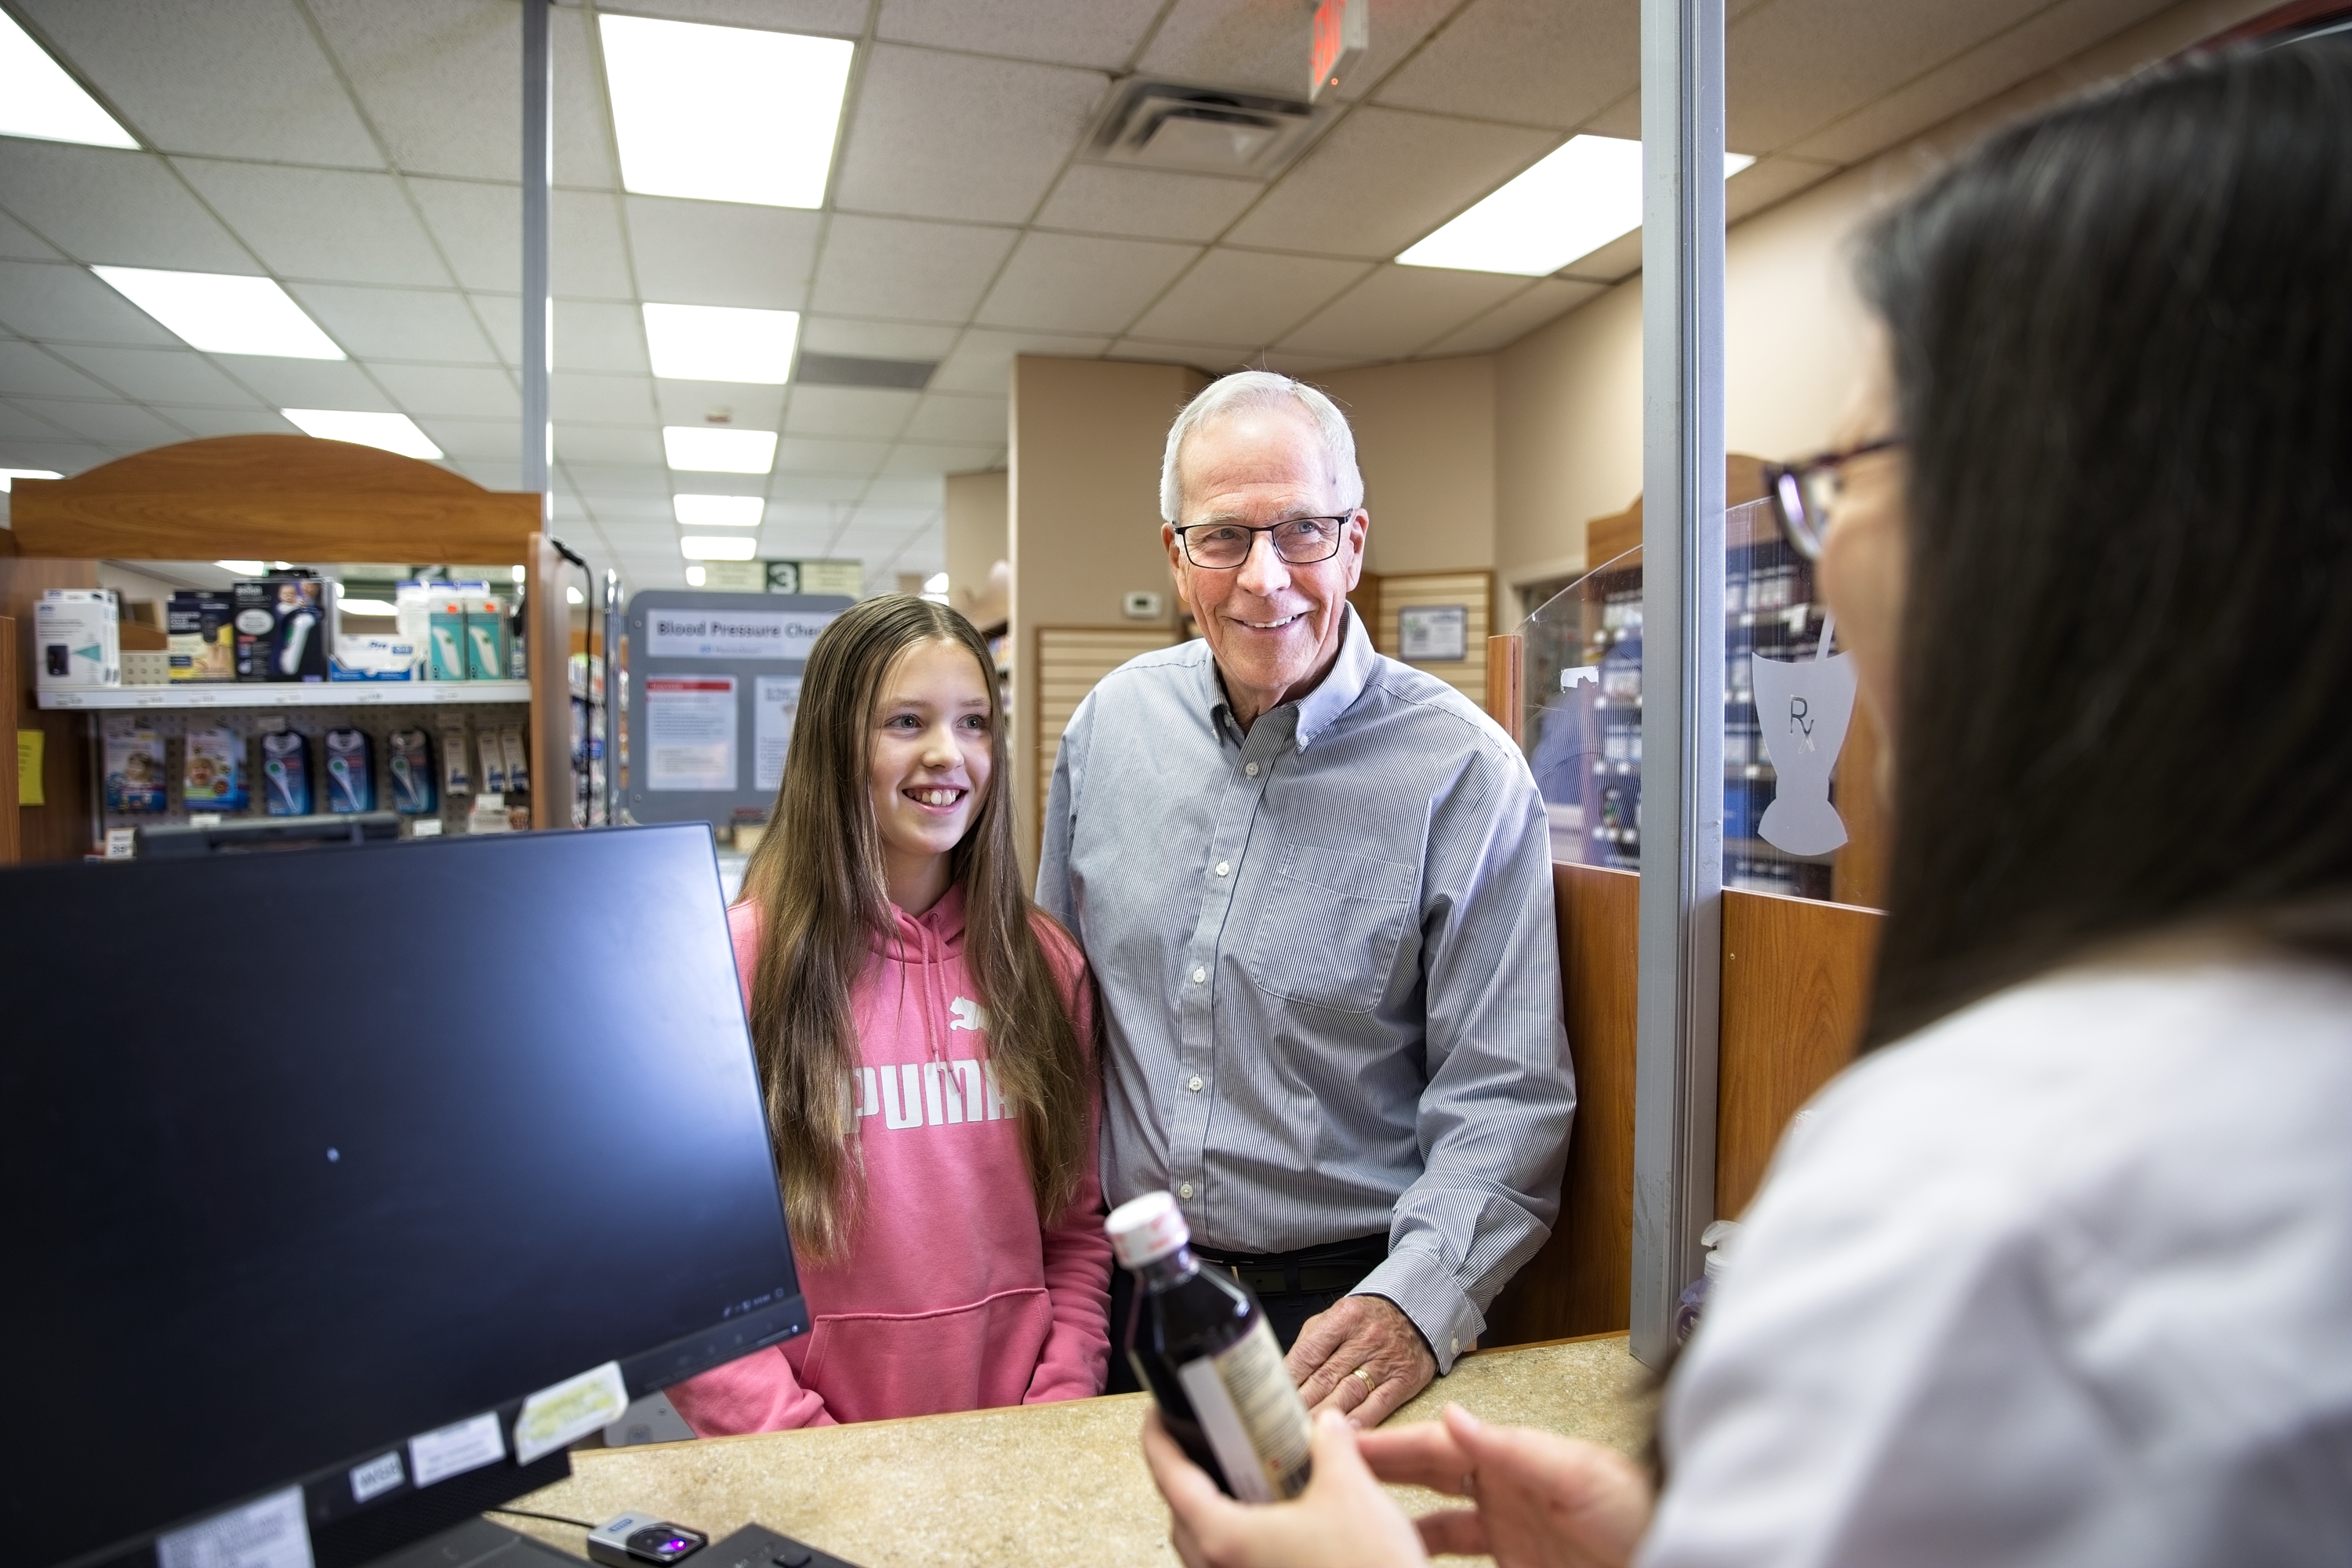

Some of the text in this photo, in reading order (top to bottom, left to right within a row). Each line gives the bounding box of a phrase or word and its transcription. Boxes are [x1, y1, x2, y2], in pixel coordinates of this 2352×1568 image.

[768, 563, 799, 594] 3
[657, 620, 706, 637] Blood
[710, 622, 781, 639] Pressure
[840, 1059, 1018, 1134] PUMA
